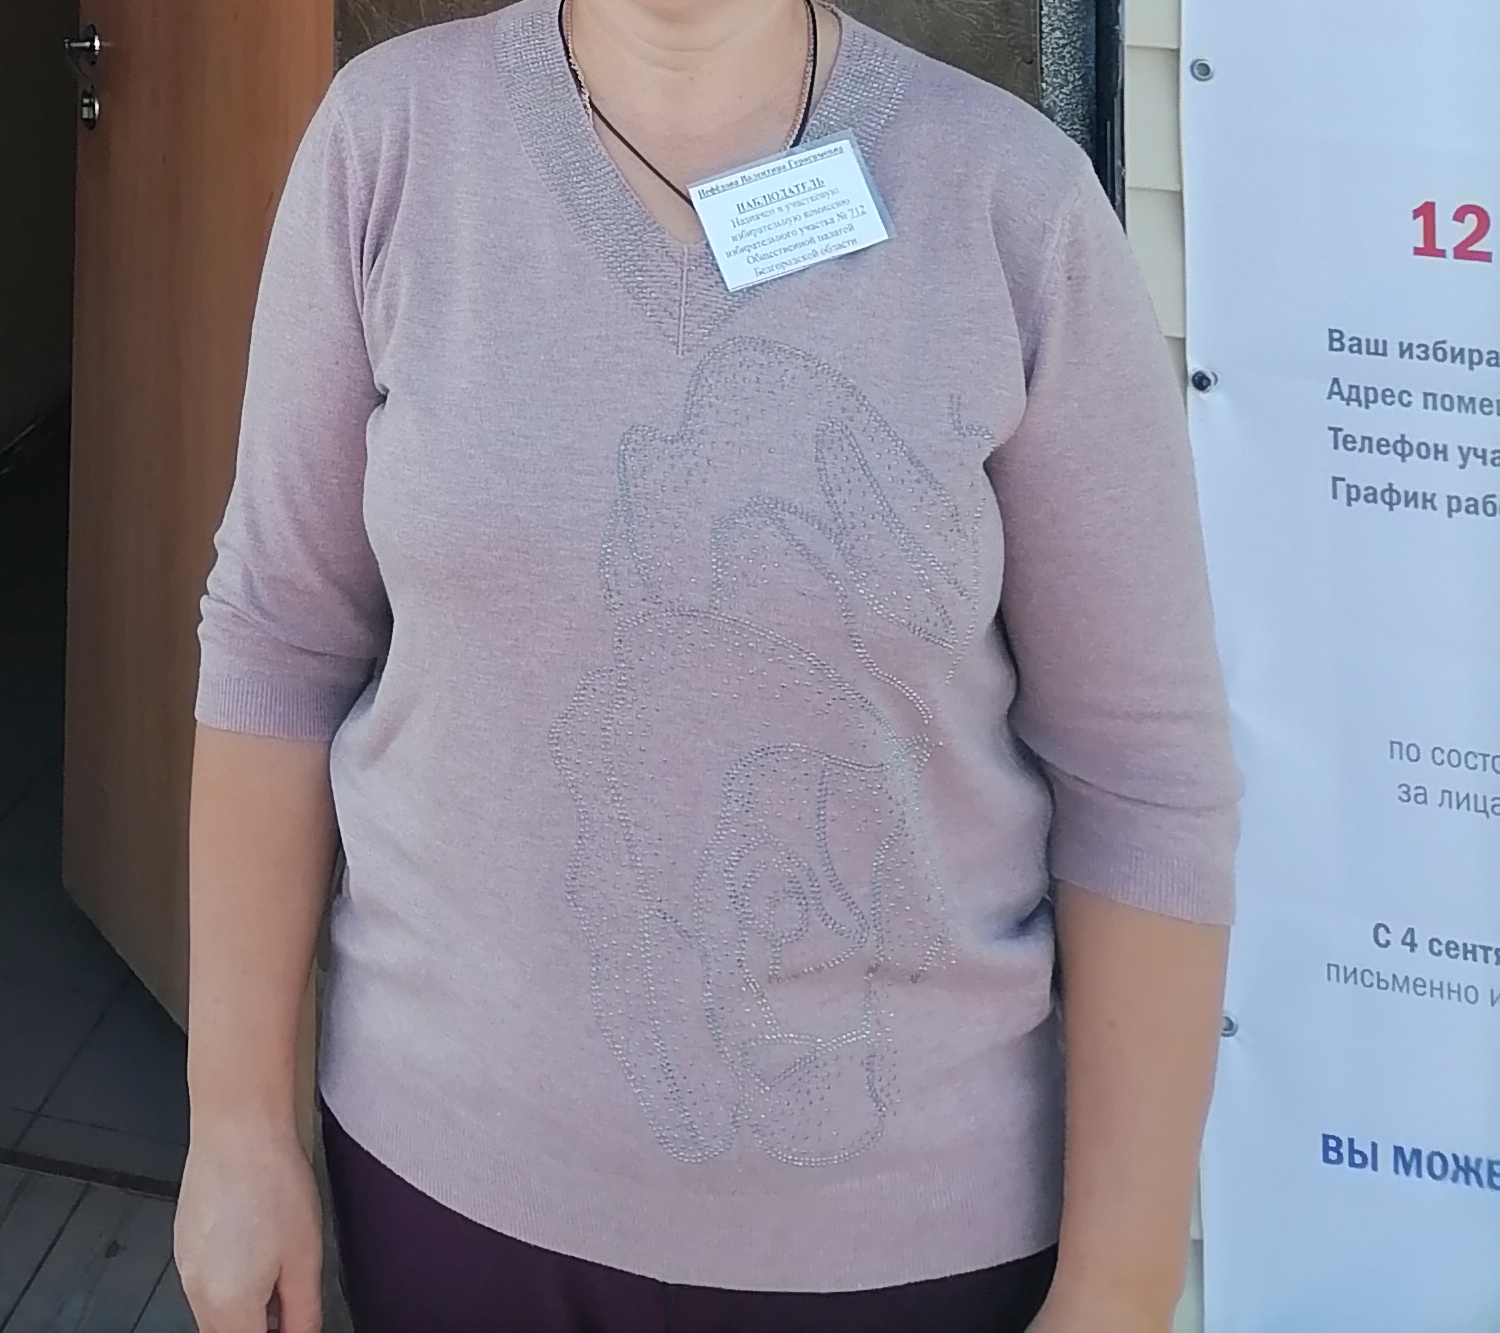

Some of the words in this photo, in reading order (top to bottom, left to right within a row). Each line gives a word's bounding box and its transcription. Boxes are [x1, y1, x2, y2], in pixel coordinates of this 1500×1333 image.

[736, 177, 826, 214] НАБЛЮДАТЕЛЬ
[725, 229, 798, 259] избирательного
[798, 215, 836, 236] участка
[847, 204, 867, 220] 712
[731, 214, 802, 242] избирательную
[1412, 201, 1493, 263] 12
[1327, 328, 1387, 357] Ваш
[1398, 339, 1500, 371] избира
[1327, 377, 1413, 409] Адрес
[1422, 391, 1500, 417] поме
[1328, 426, 1449, 463] Телефон
[1331, 476, 1438, 512] График
[1446, 493, 1500, 519] раб
[1389, 740, 1421, 763] по
[1398, 783, 1428, 806] за
[1373, 922, 1392, 949] С
[1400, 927, 1418, 954] 4
[1326, 962, 1479, 1006] письменно
[1322, 1132, 1379, 1173] ВЫ
[1393, 1144, 1500, 1191] МОЖЕ
